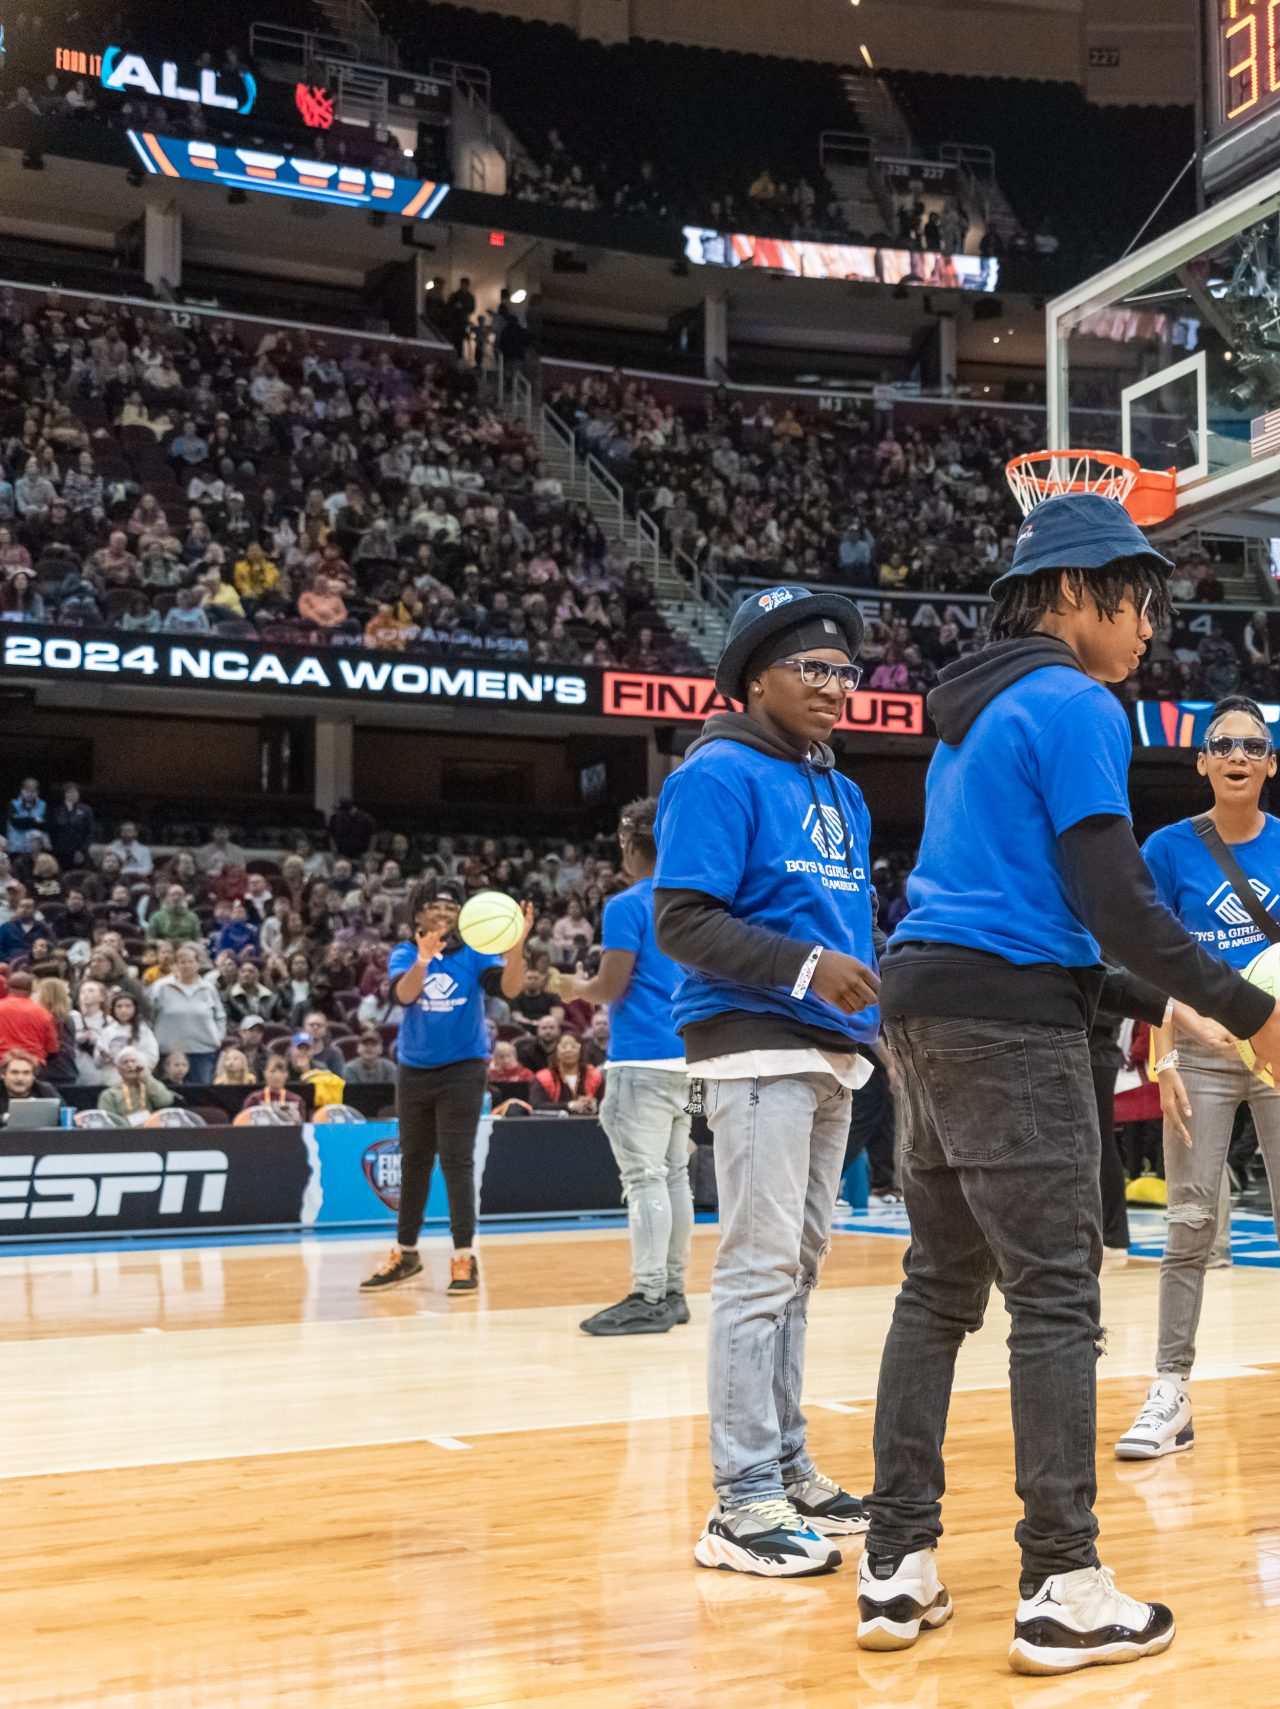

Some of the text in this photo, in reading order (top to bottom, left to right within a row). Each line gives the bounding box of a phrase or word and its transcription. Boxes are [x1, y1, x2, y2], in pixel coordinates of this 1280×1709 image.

[5, 636, 913, 728] 2024 NCAA WOMEN'S FINA UR
[785, 860, 818, 874] BOYS
[829, 882, 860, 892] AMERICA
[1217, 930, 1227, 940] &
[1218, 933, 1266, 950] OF AMERIC
[378, 1153, 403, 1170] FIN
[0, 1149, 229, 1219] ESPN
